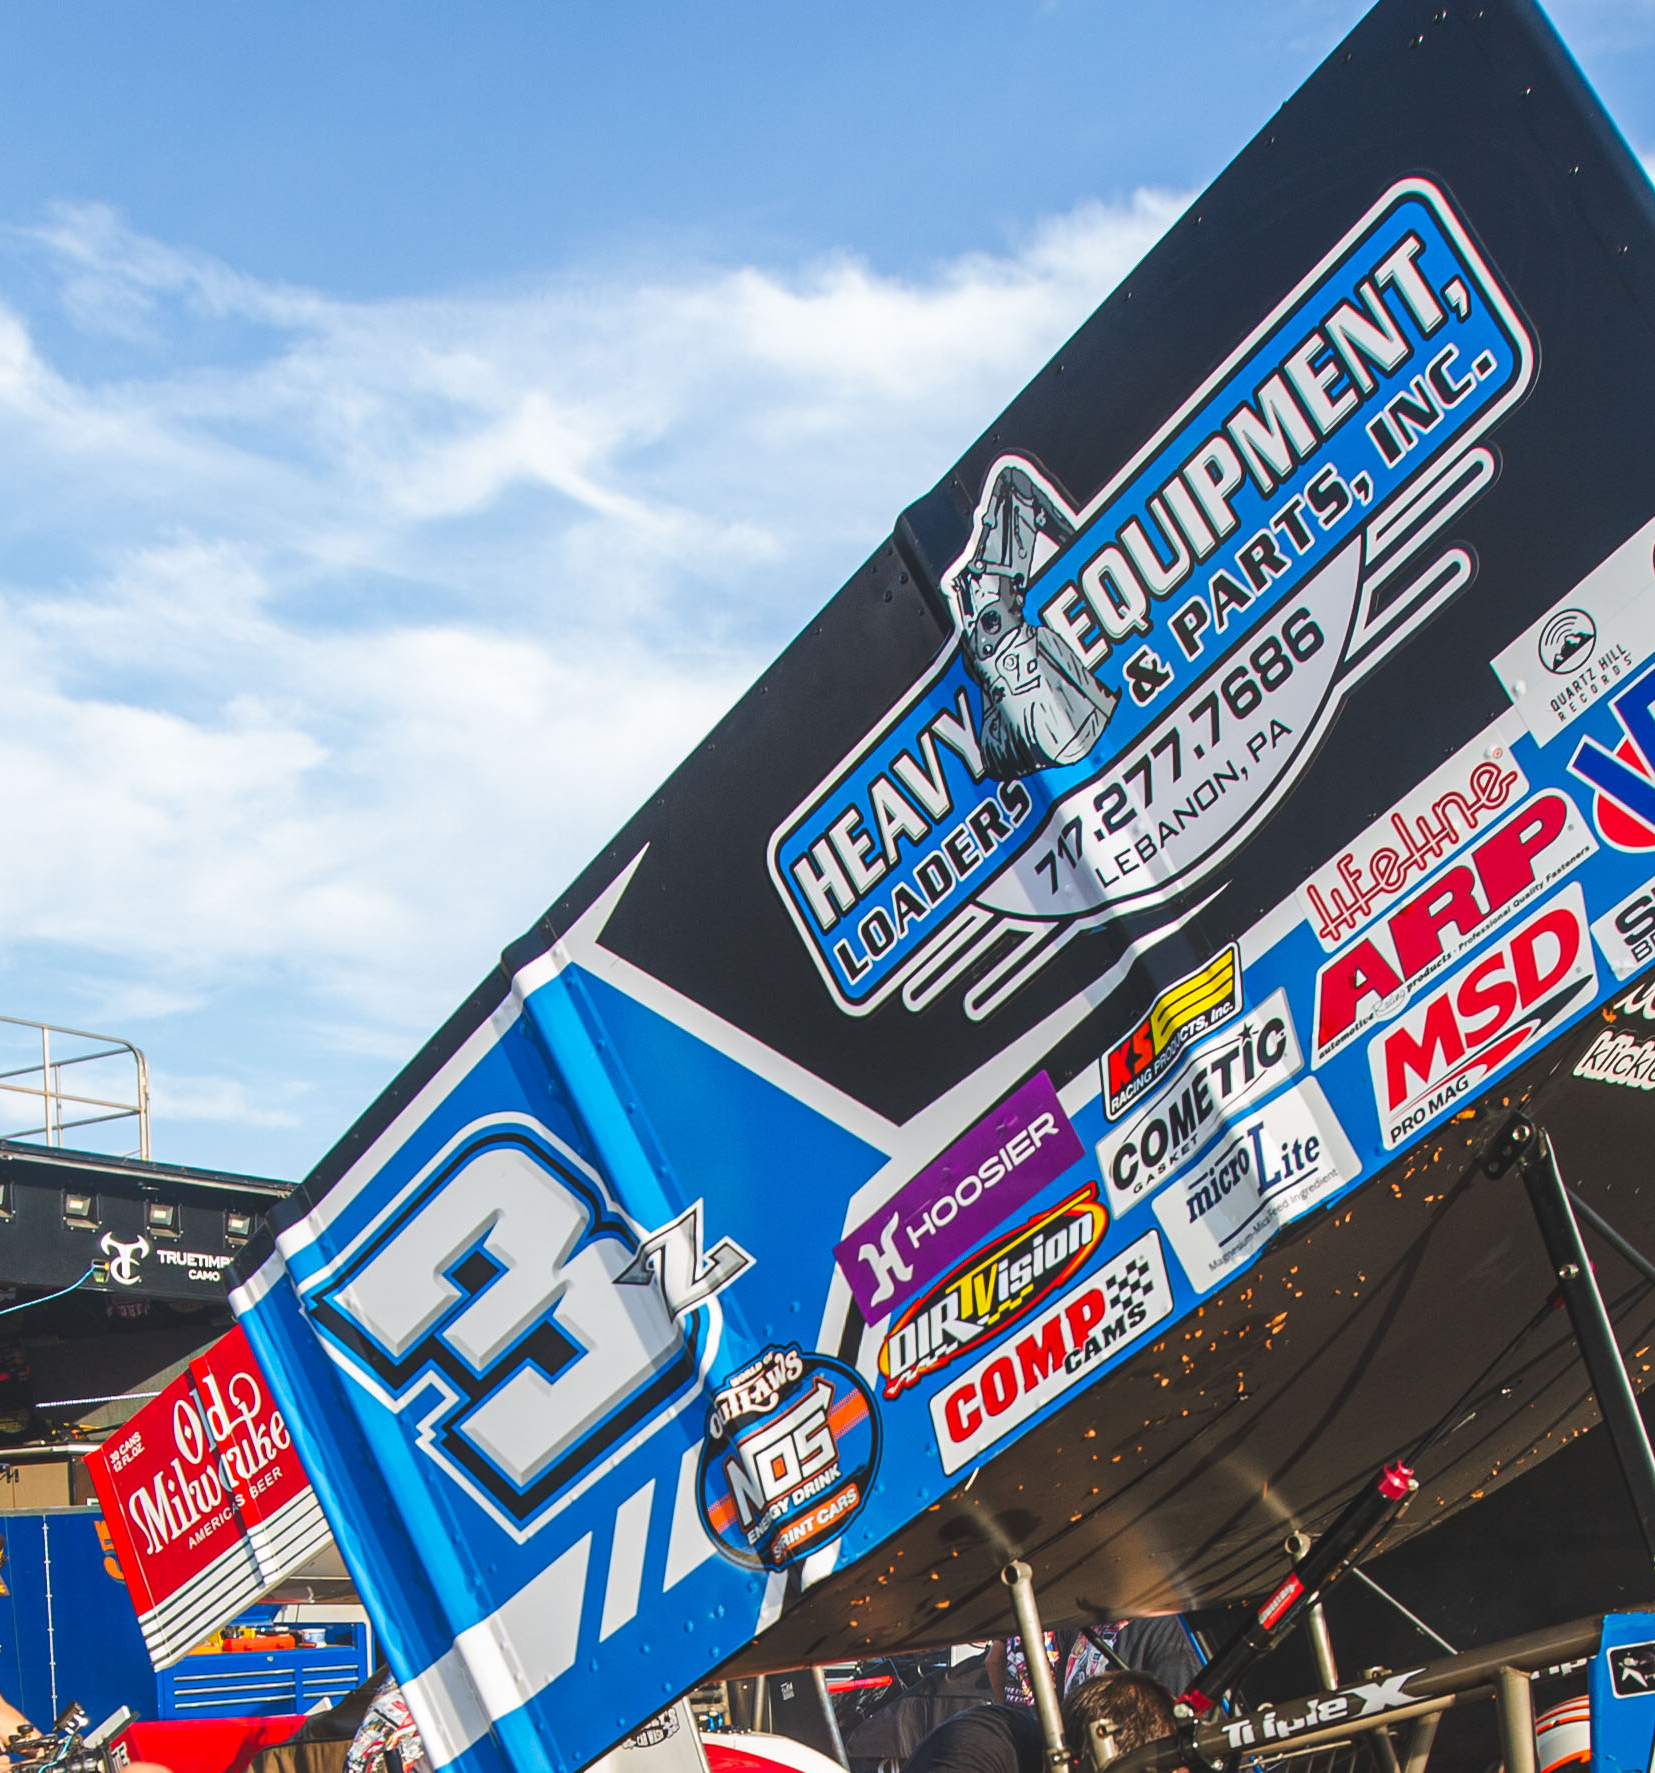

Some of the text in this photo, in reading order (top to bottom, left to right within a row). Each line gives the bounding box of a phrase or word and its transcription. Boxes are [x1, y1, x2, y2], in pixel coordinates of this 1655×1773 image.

[792, 233, 1474, 932] HEAVY EQUIPMENT,
[834, 348, 1500, 980] LOADERS & PARTS, INC.
[1549, 643, 1627, 712] QUARTZ HILL
[1558, 654, 1633, 722] RECORDS
[1034, 608, 1327, 895] 717.277.7686
[1094, 719, 1294, 889] LEBANON, PA
[1318, 795, 1568, 1050] ARP
[1318, 1012, 1375, 1060] automotive
[1406, 951, 1453, 994] products
[1458, 905, 1512, 952] Professional
[1512, 880, 1546, 909] Quality
[1545, 845, 1592, 883] Fasteners
[1111, 1068, 1153, 1114] RACING
[1210, 1000, 1235, 1022] Inc.
[1384, 908, 1581, 1113] MSD
[1111, 1017, 1287, 1192] COMETIC
[1389, 1074, 1470, 1147] PRO MAG
[903, 1112, 1060, 1248] HOOSIER
[1133, 1133, 1198, 1195] GASKET
[188, 1269, 221, 1282] CAMO
[313, 1130, 702, 1522] 3
[943, 1287, 1106, 1445] COMP
[1063, 1303, 1147, 1376] CAMS
[119, 1431, 142, 1456] CANS
[174, 1374, 233, 1464] Old
[709, 1350, 803, 1439] OUTLAWS
[113, 1461, 123, 1472] 12
[249, 1466, 283, 1499] BEER
[726, 1381, 838, 1529] NOS
[747, 1464, 842, 1545] ENERGY DRINK
[816, 1487, 858, 1524] CARS
